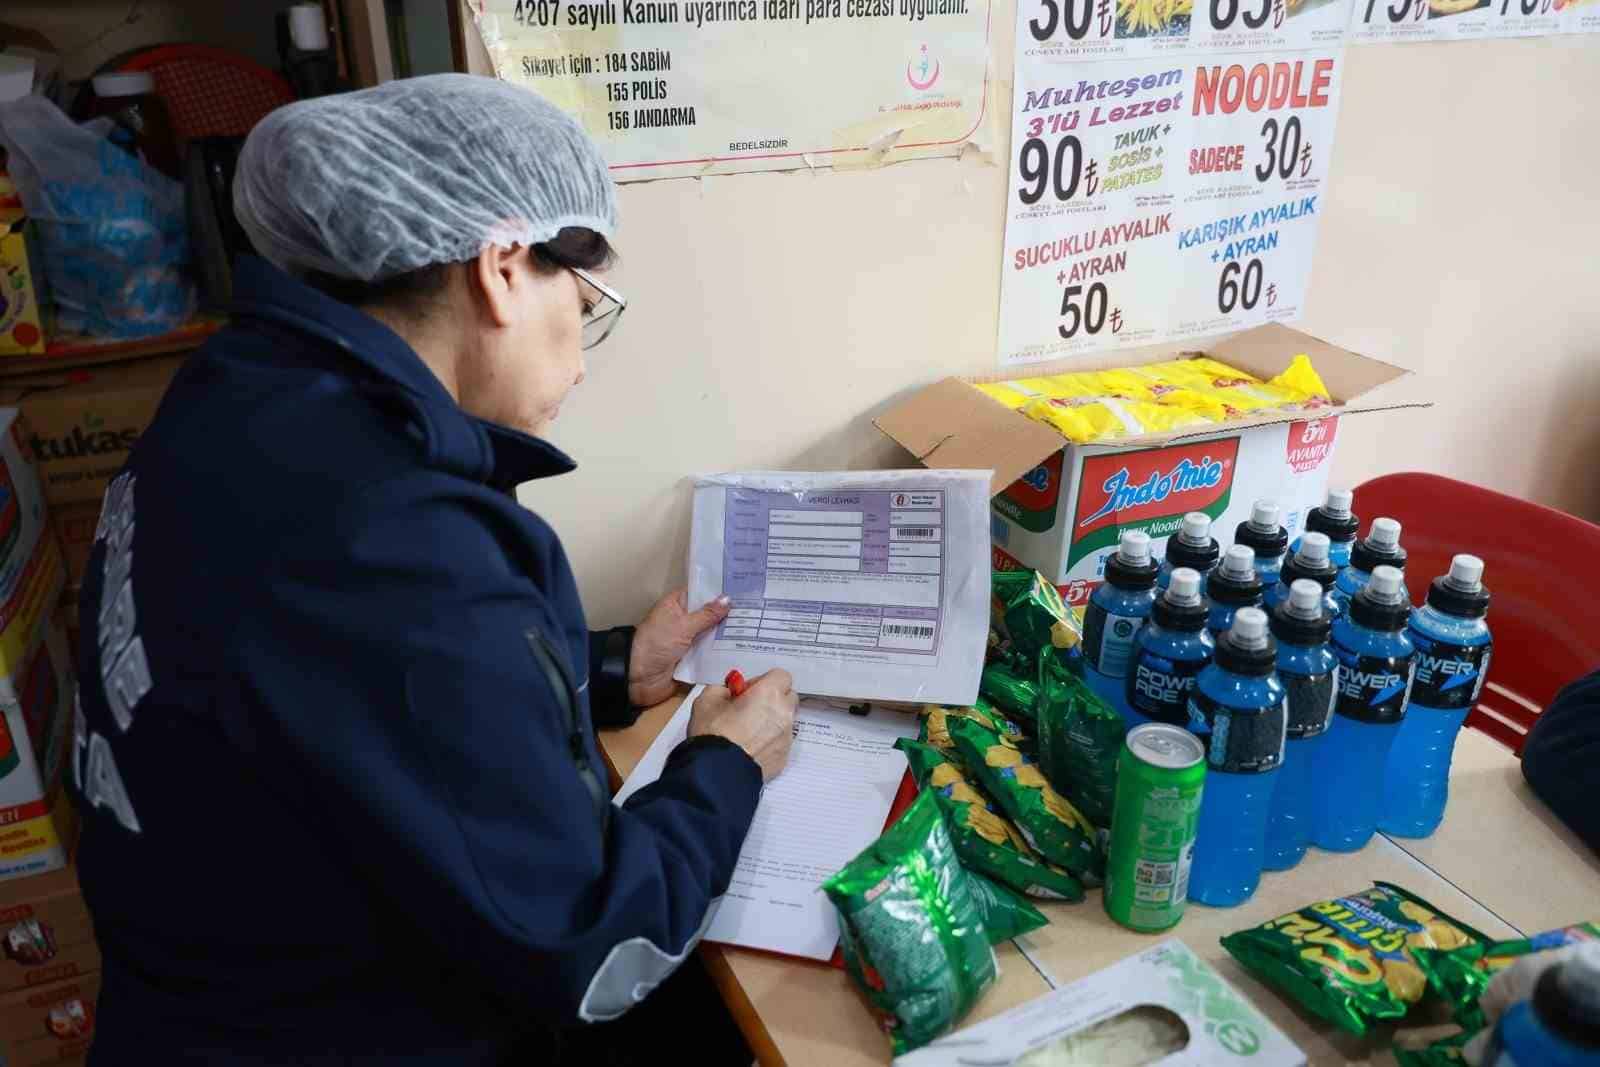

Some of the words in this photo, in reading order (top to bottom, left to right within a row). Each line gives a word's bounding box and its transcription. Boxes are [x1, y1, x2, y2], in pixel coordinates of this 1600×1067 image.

[514, 0, 560, 26] 4207
[567, 0, 616, 31] sayılı
[623, 0, 679, 24] Kanun
[684, 0, 757, 28] uyarınca
[806, 0, 841, 24] para
[568, 53, 592, 77] için
[604, 53, 628, 73] 184
[630, 48, 671, 72] SABİM
[606, 82, 629, 102] 155
[632, 77, 667, 101] POLİS
[1022, 68, 1184, 113] Muhteşem
[1192, 59, 1334, 117] NOODLE
[607, 111, 630, 130] 156
[632, 106, 697, 129] JANDARMA
[1088, 91, 1184, 127] Lezzet
[1114, 124, 1161, 150] TAVUK
[1107, 145, 1152, 172] SOSİS
[1188, 145, 1245, 176] SADECE
[1100, 163, 1164, 194] PATATES
[1177, 215, 1246, 250] KARIŞIK
[1248, 195, 1319, 228] AYVALIK
[1014, 230, 1096, 271] SUCUKLU
[1098, 212, 1173, 250] AYVALIK
[1222, 230, 1280, 262] AYRAN
[1067, 251, 1128, 284] AYRAN
[1149, 517, 1185, 535] Noodl
[1136, 663, 1197, 691] POWE
[1338, 663, 1401, 690] OWER
[1414, 651, 1475, 676] OWER
